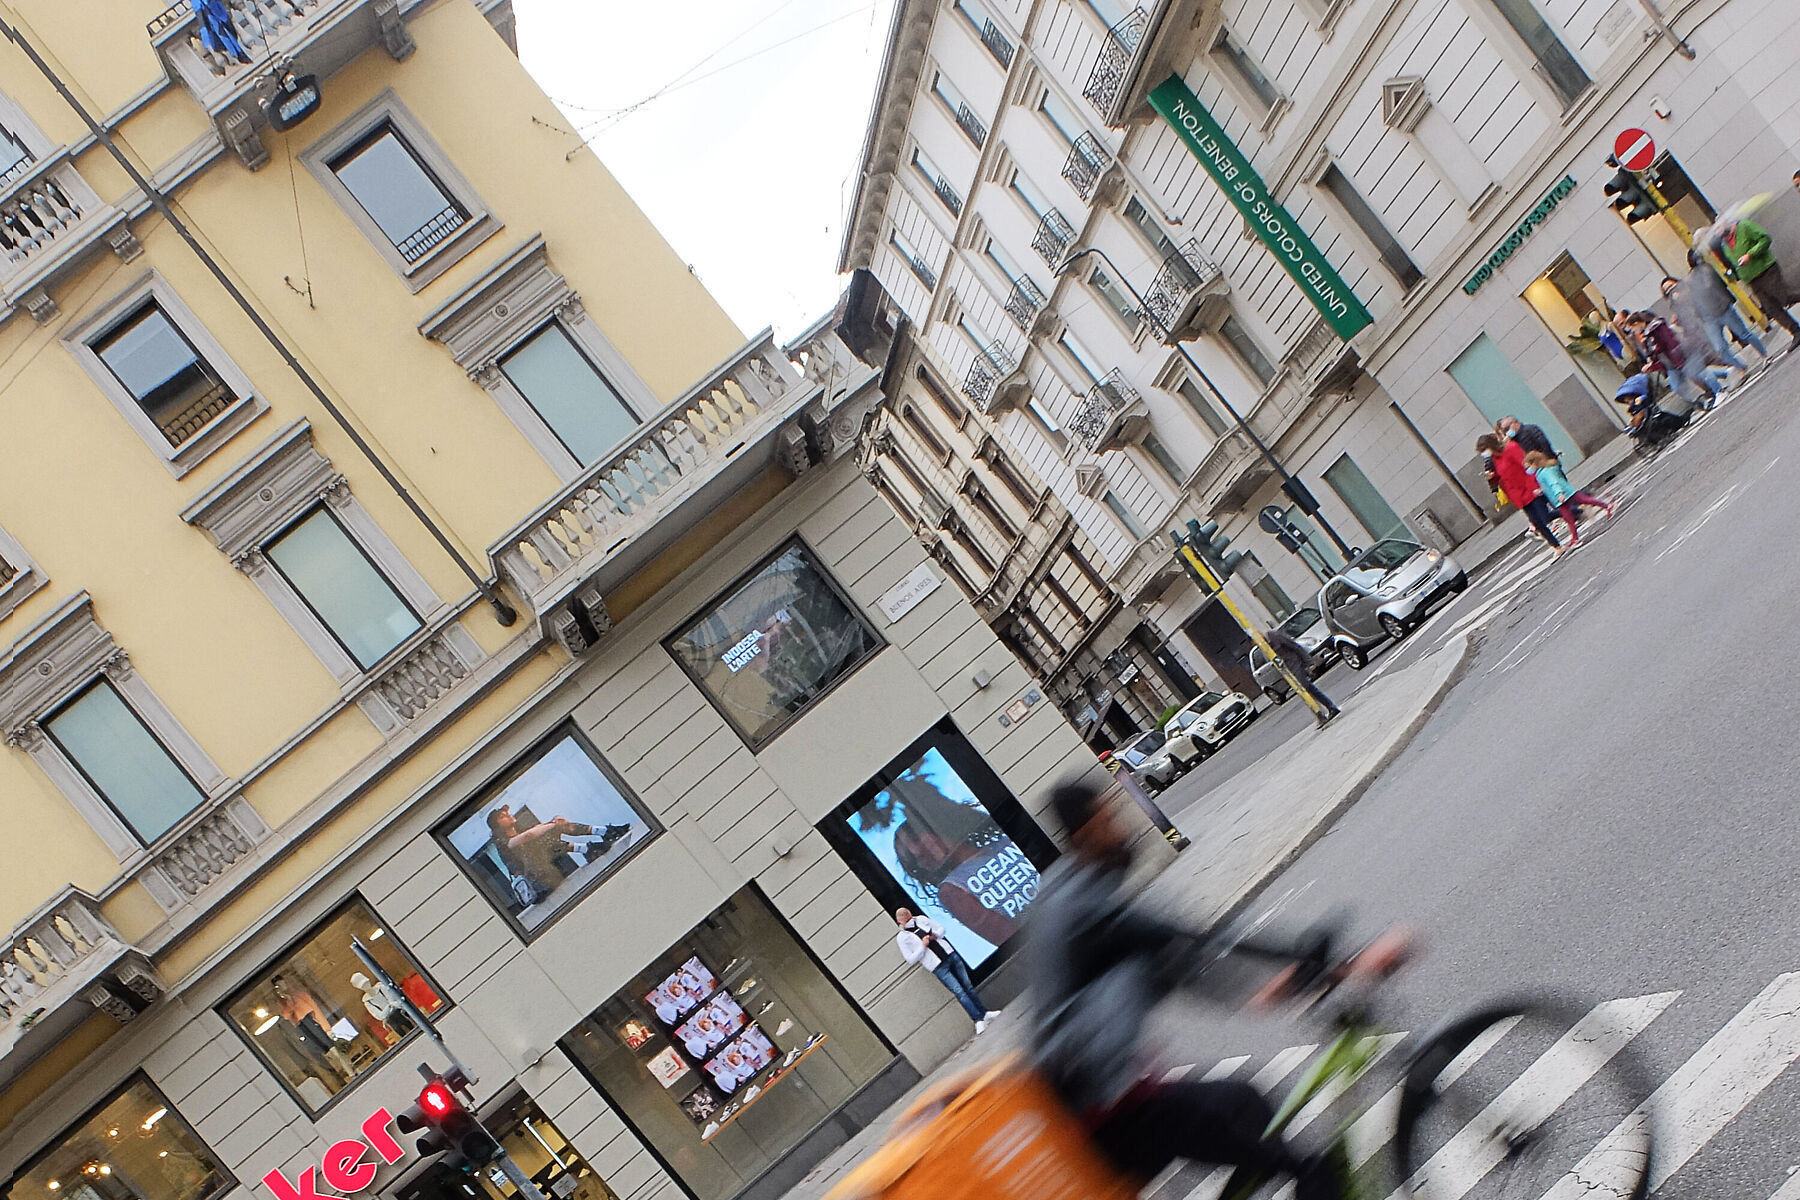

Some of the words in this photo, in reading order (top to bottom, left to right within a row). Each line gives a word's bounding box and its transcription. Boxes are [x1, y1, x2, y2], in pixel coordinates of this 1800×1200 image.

[1234, 183, 1257, 202] OF
[1252, 201, 1303, 262] COLORS
[1301, 261, 1348, 318] UNITED
[889, 593, 914, 614] BUENOS
[914, 577, 932, 592] AIRES
[728, 644, 761, 672] L'ARTE
[967, 841, 1024, 893] OCEAN
[980, 857, 1037, 909] QUEEN
